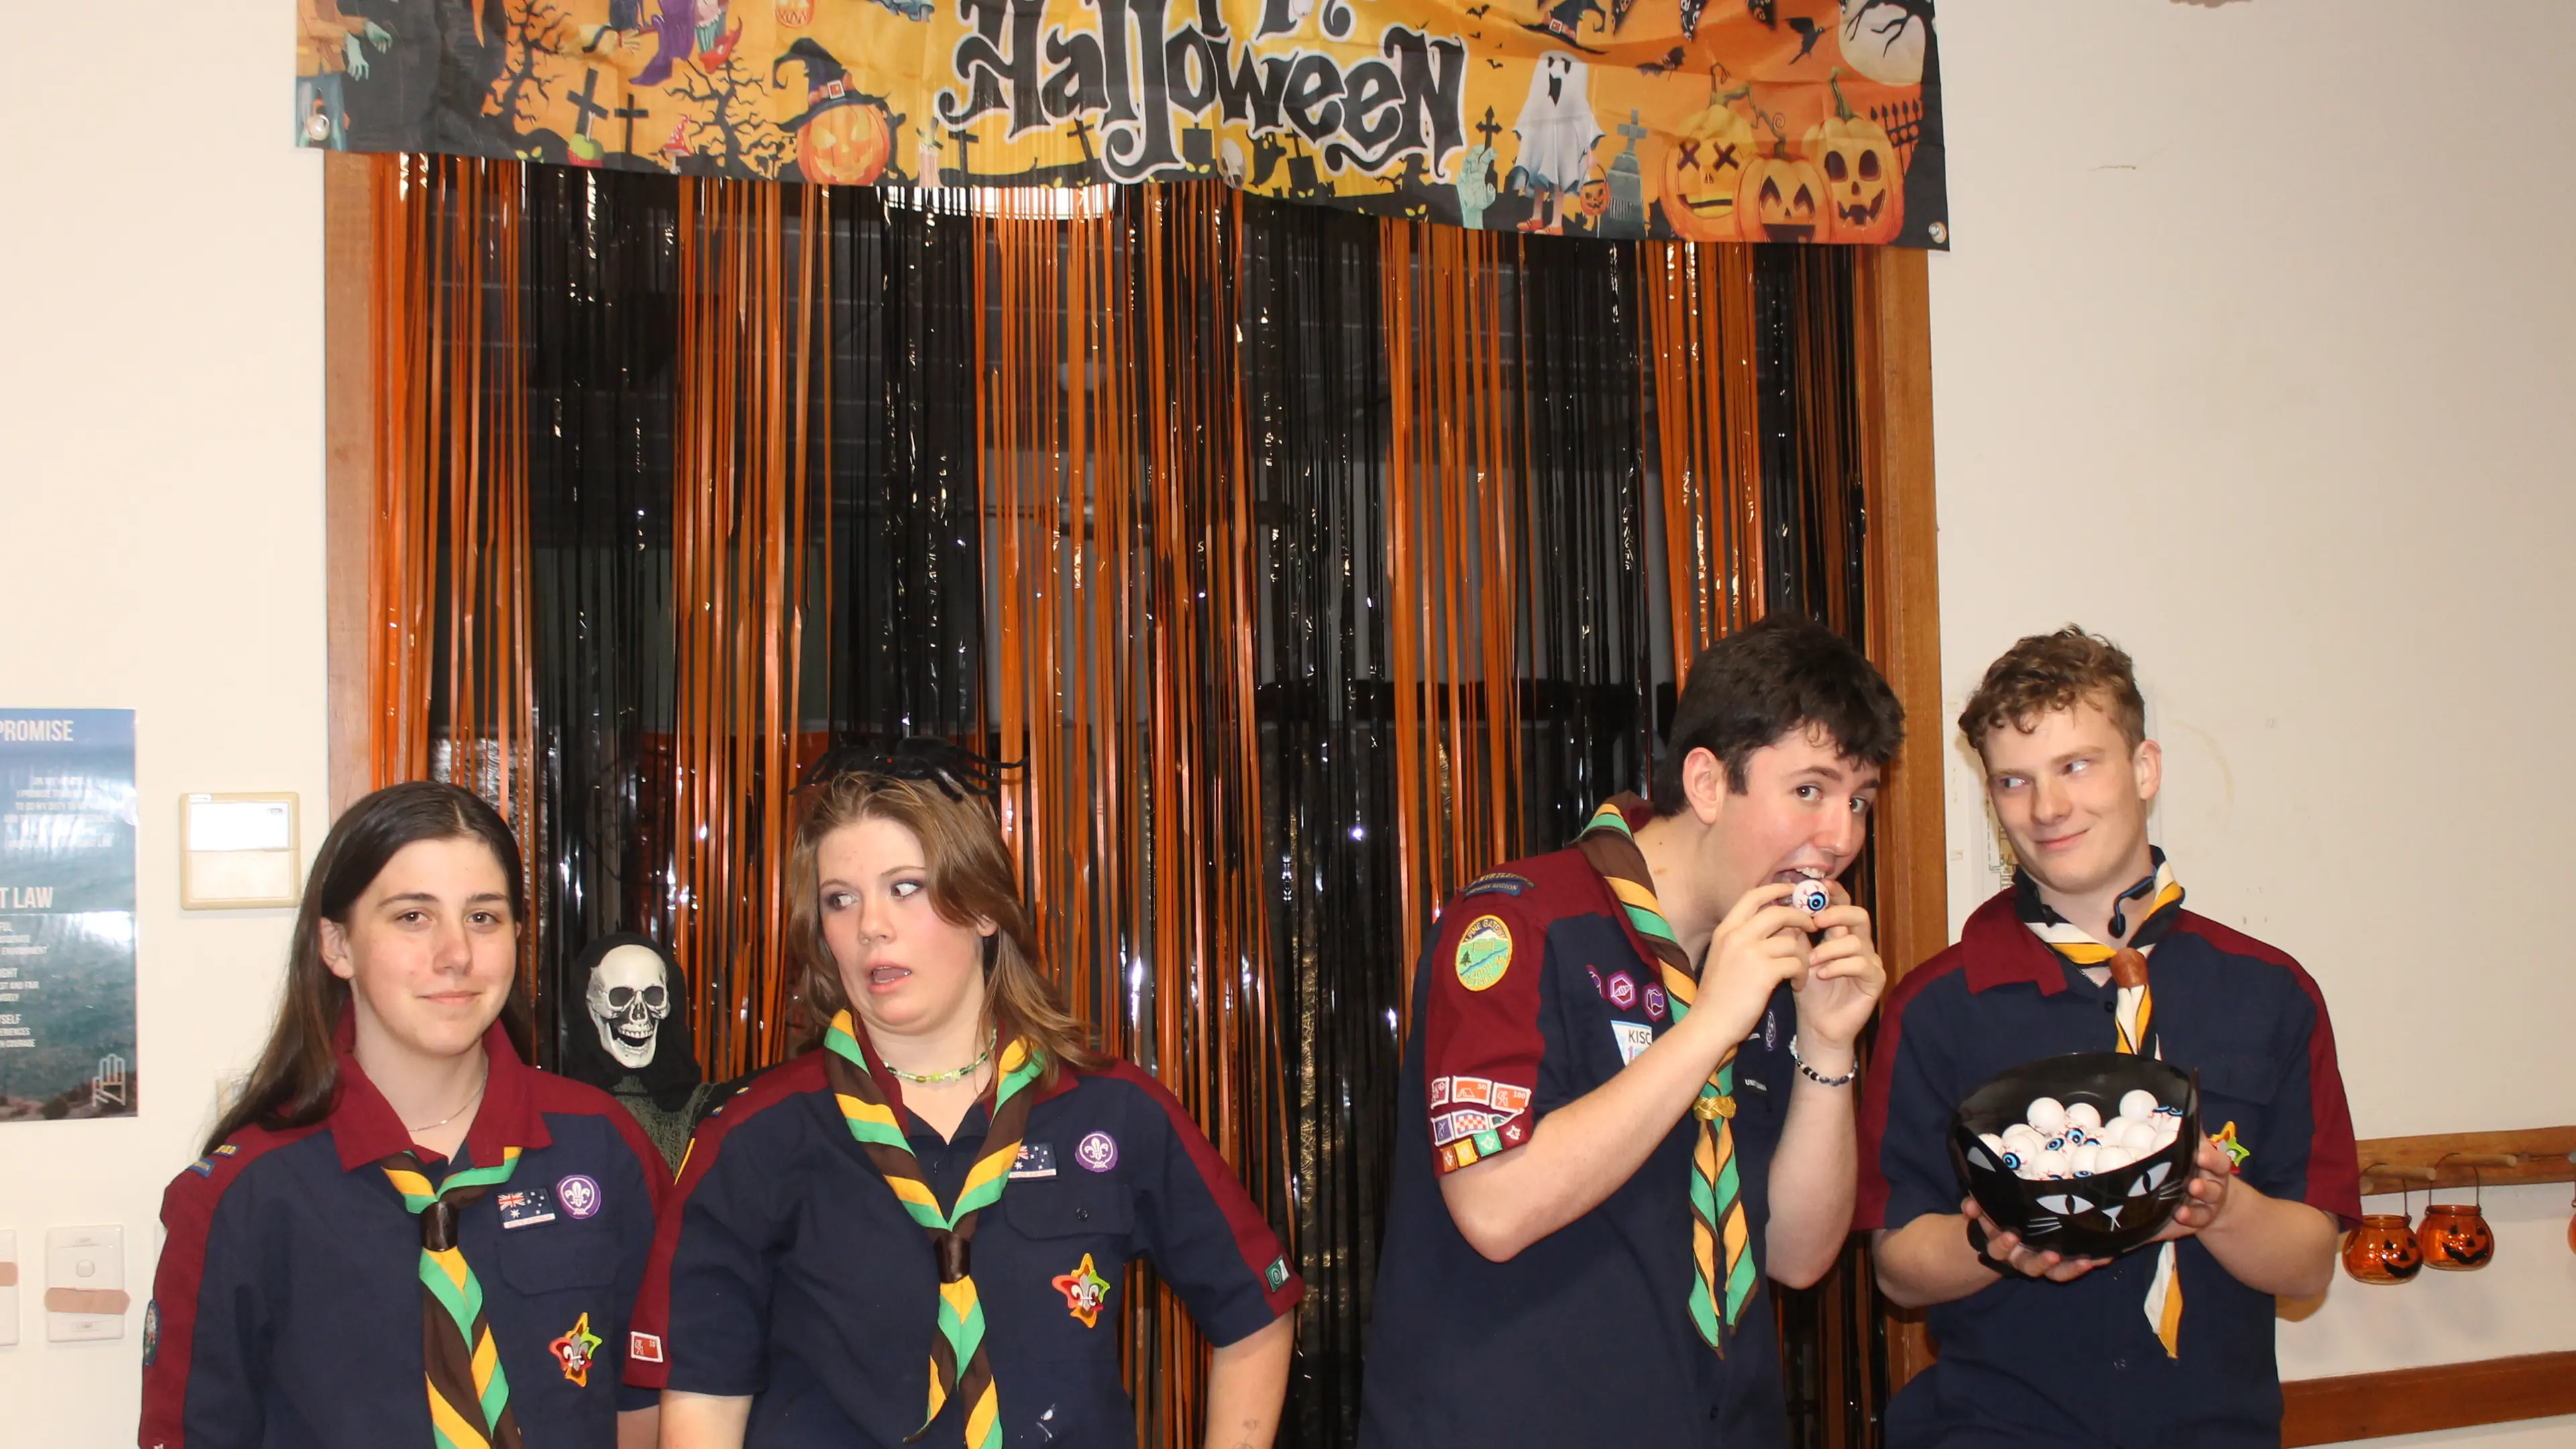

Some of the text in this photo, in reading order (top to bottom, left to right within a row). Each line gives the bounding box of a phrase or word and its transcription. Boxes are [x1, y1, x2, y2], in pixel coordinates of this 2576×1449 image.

[13, 887, 54, 908] LAW
[1477, 1083, 1487, 1091] 50
[1513, 1090, 1526, 1099] 100
